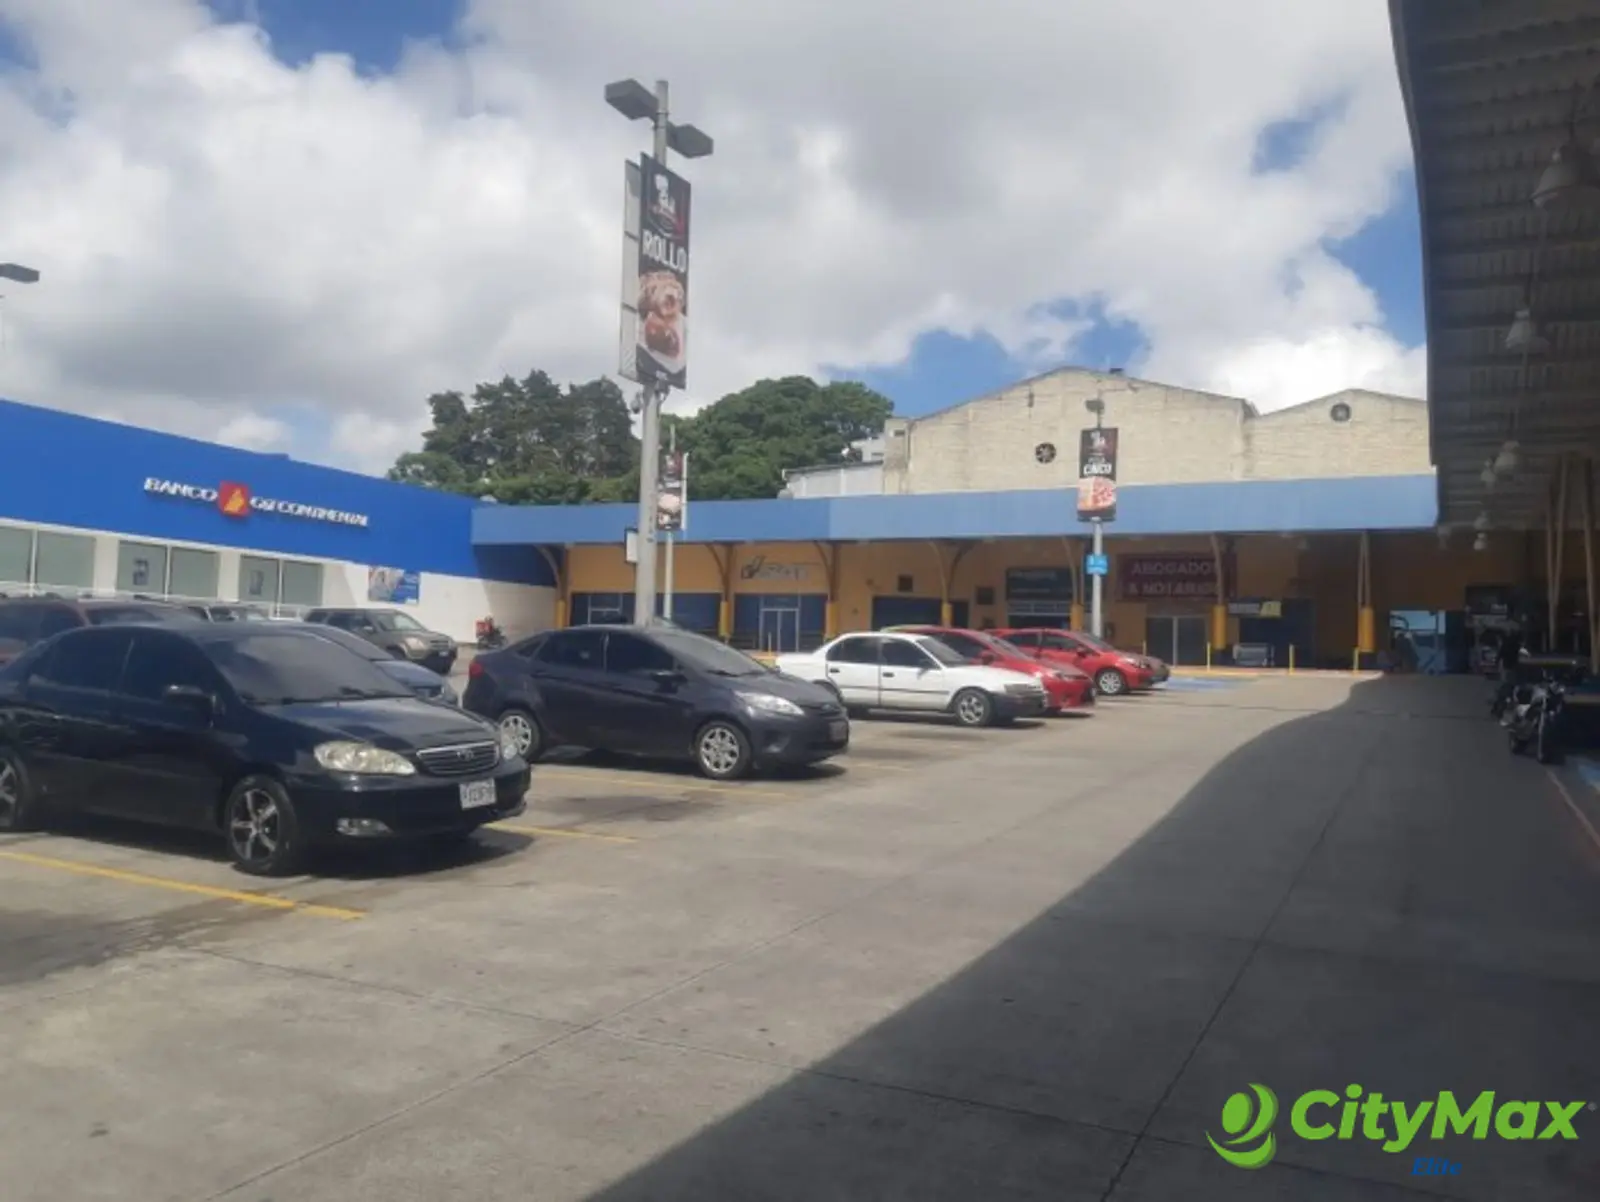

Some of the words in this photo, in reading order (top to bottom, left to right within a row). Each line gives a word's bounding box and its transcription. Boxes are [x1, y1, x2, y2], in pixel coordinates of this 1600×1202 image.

[642, 229, 686, 273] ROLLO
[143, 476, 218, 501] BANCO
[1131, 561, 1216, 575] ABOGADO
